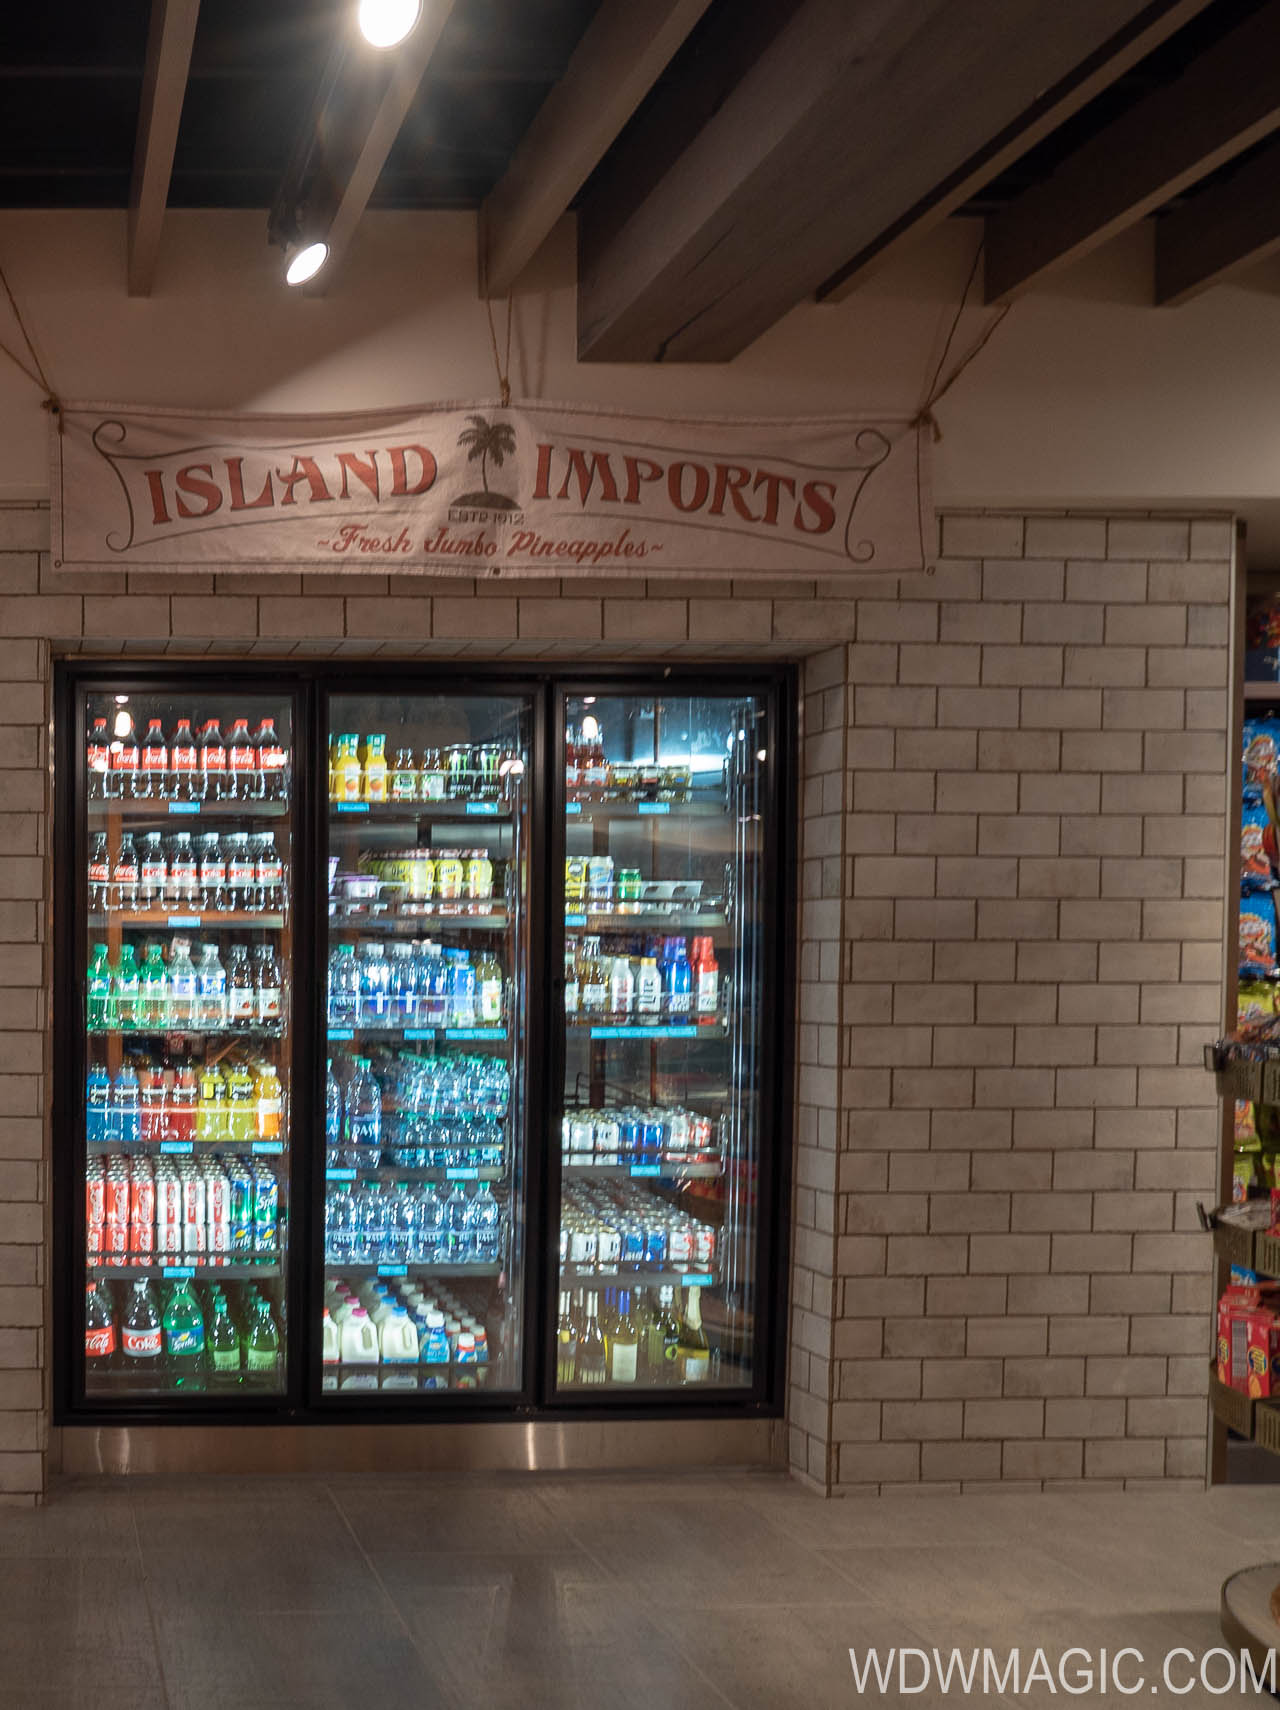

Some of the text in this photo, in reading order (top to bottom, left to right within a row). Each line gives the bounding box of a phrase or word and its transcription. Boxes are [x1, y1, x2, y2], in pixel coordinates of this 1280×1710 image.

[144, 443, 838, 535] ISLAND IMPORTS
[424, 527, 499, 558] Jumbo
[127, 1335, 160, 1352] Coke
